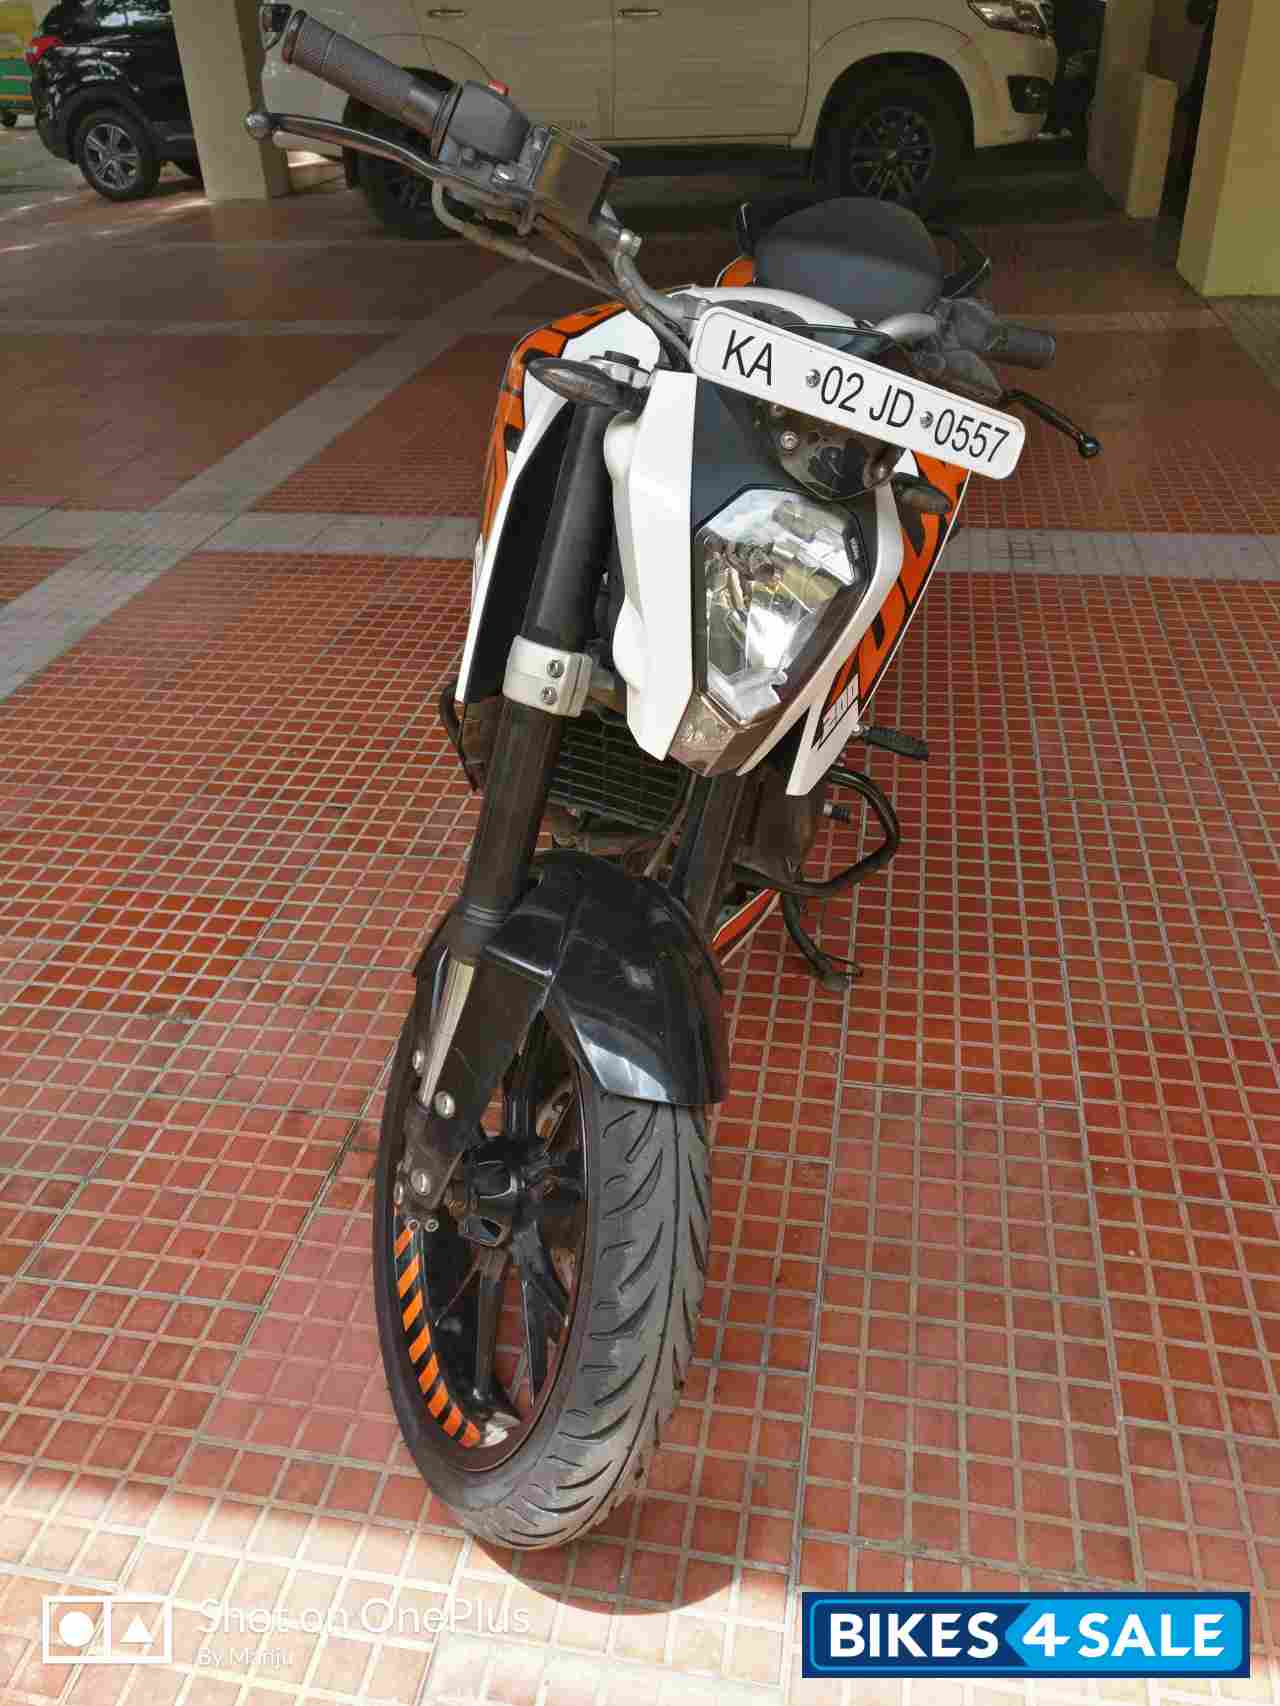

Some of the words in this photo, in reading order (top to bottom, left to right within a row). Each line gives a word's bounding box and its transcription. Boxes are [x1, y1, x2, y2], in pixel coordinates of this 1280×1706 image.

[721, 329, 773, 386] KA
[820, 366, 864, 413] 02
[869, 385, 914, 428] JD
[934, 408, 1010, 463] 0557
